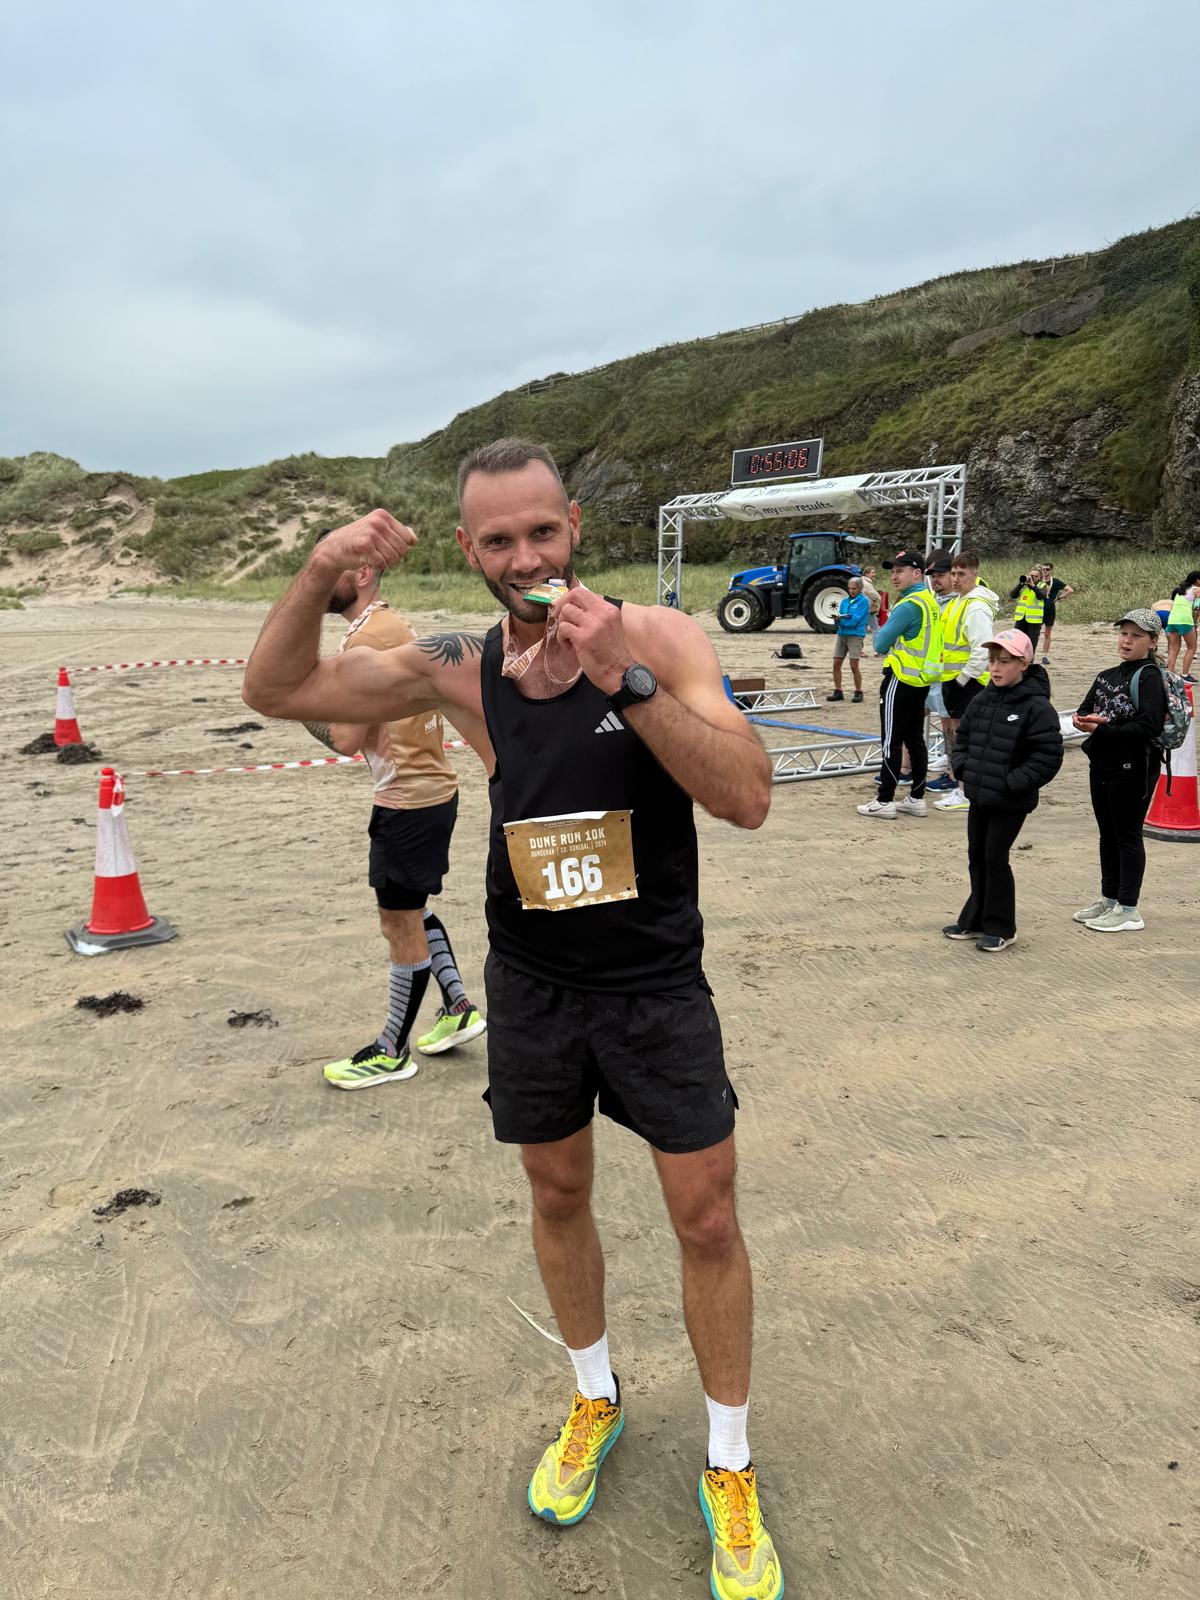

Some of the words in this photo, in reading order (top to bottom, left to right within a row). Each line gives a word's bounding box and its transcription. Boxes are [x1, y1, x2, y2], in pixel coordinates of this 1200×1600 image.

[751, 448, 808, 474] 0:55:06
[762, 501, 832, 514] myrunresults
[529, 835, 557, 849] DUNE
[560, 831, 581, 845] RUN
[585, 827, 605, 841] 10K
[569, 843, 589, 852] DONEGAL
[595, 839, 607, 848] 2024
[541, 854, 603, 899] 166
